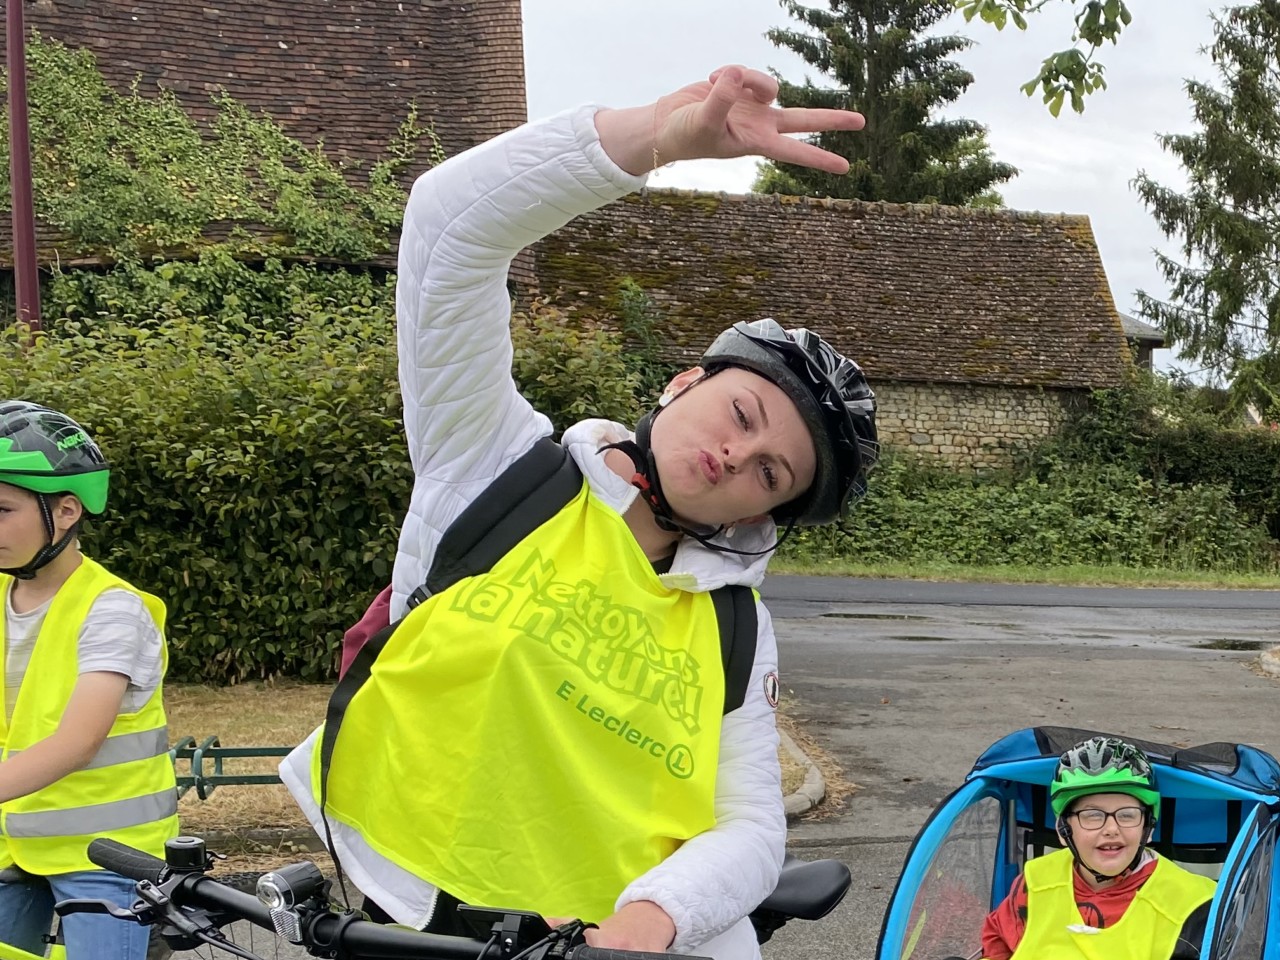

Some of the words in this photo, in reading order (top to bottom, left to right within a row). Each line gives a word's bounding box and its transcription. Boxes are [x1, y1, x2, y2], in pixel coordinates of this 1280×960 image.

[448, 576, 514, 623] la
[508, 594, 704, 737] nature!
[508, 547, 702, 686] Nettoyons
[576, 694, 666, 758] Leclerc
